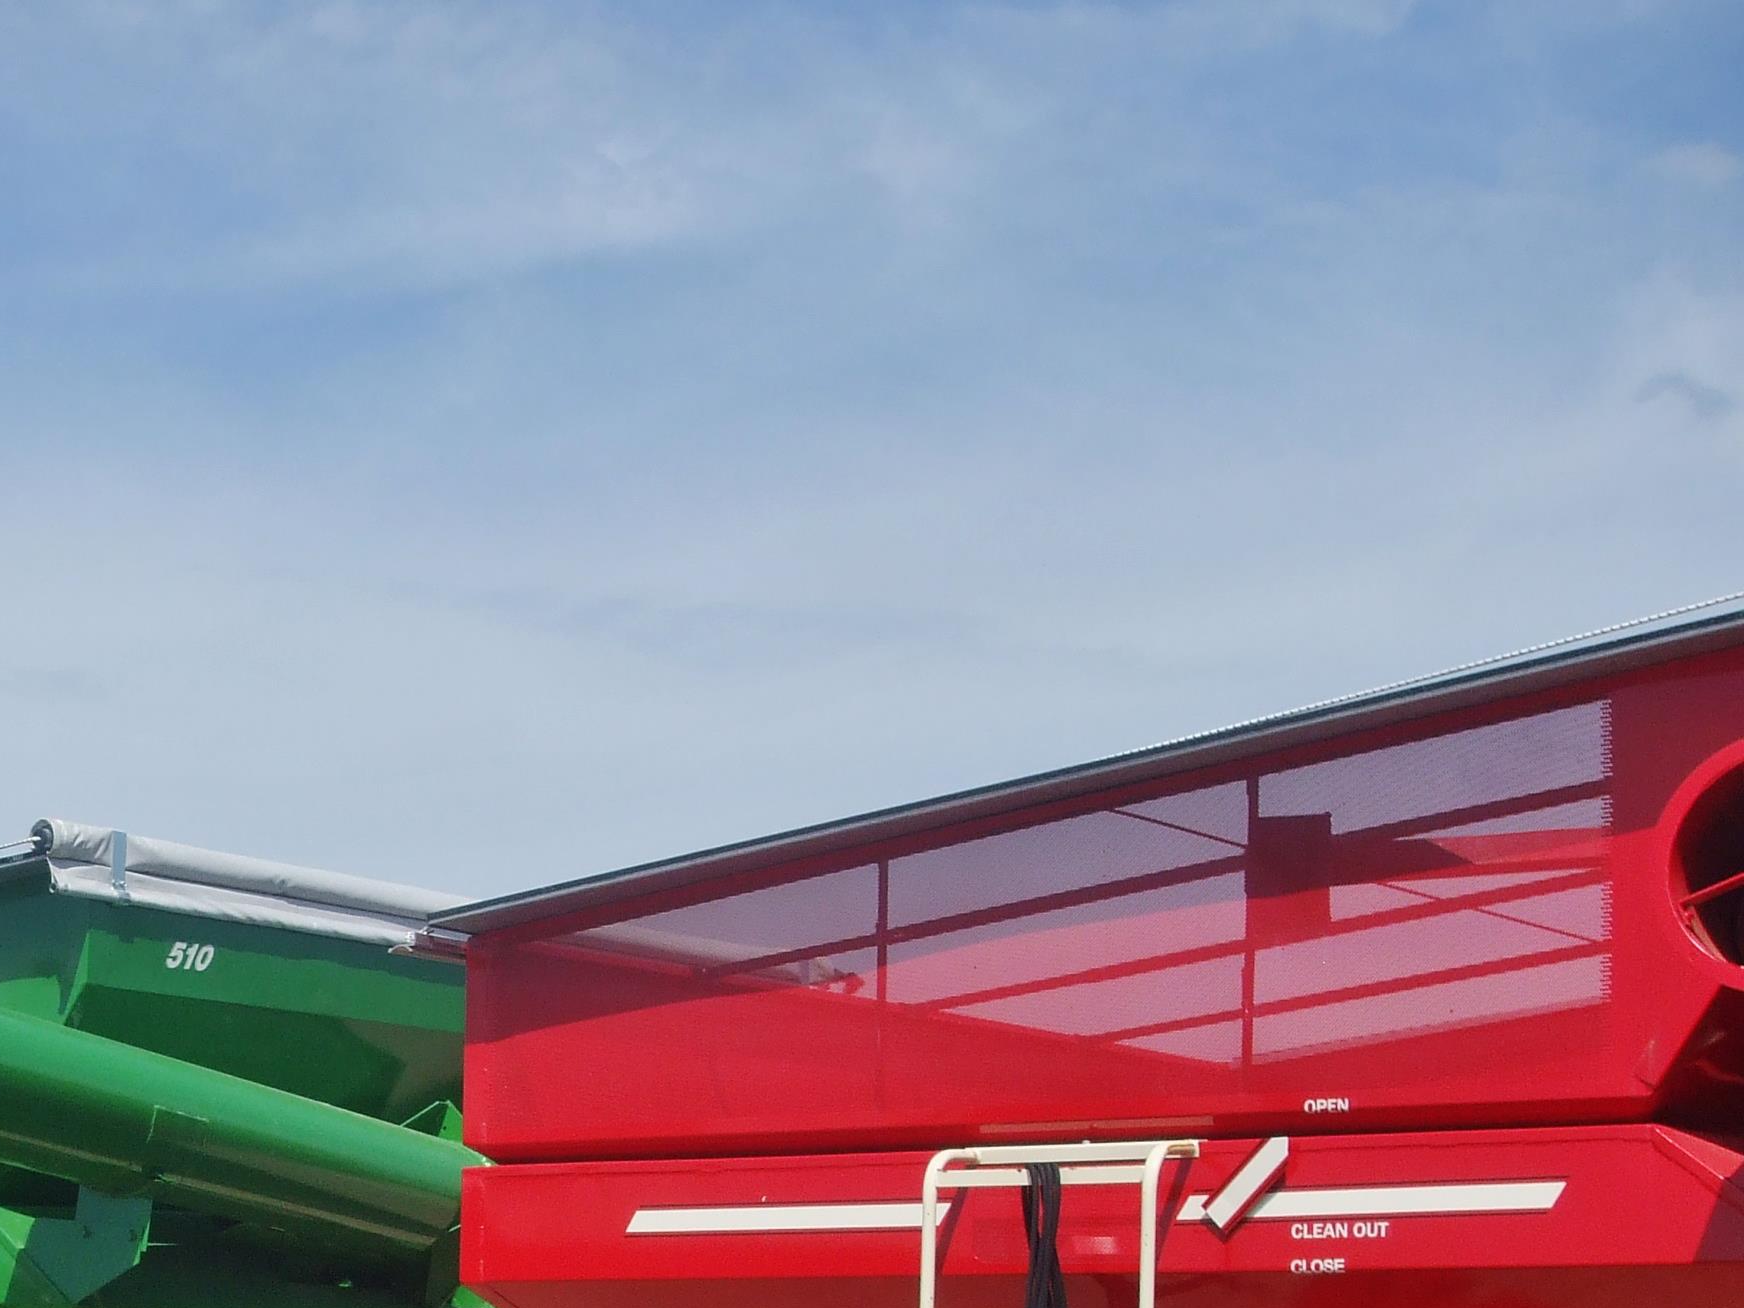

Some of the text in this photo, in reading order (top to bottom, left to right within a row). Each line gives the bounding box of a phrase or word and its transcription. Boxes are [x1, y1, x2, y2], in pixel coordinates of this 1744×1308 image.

[166, 941, 215, 971] 510
[1304, 1098, 1350, 1113] OPEN
[1291, 1221, 1390, 1239] CLEAN OUT
[1290, 1258, 1345, 1274] CLOSE
